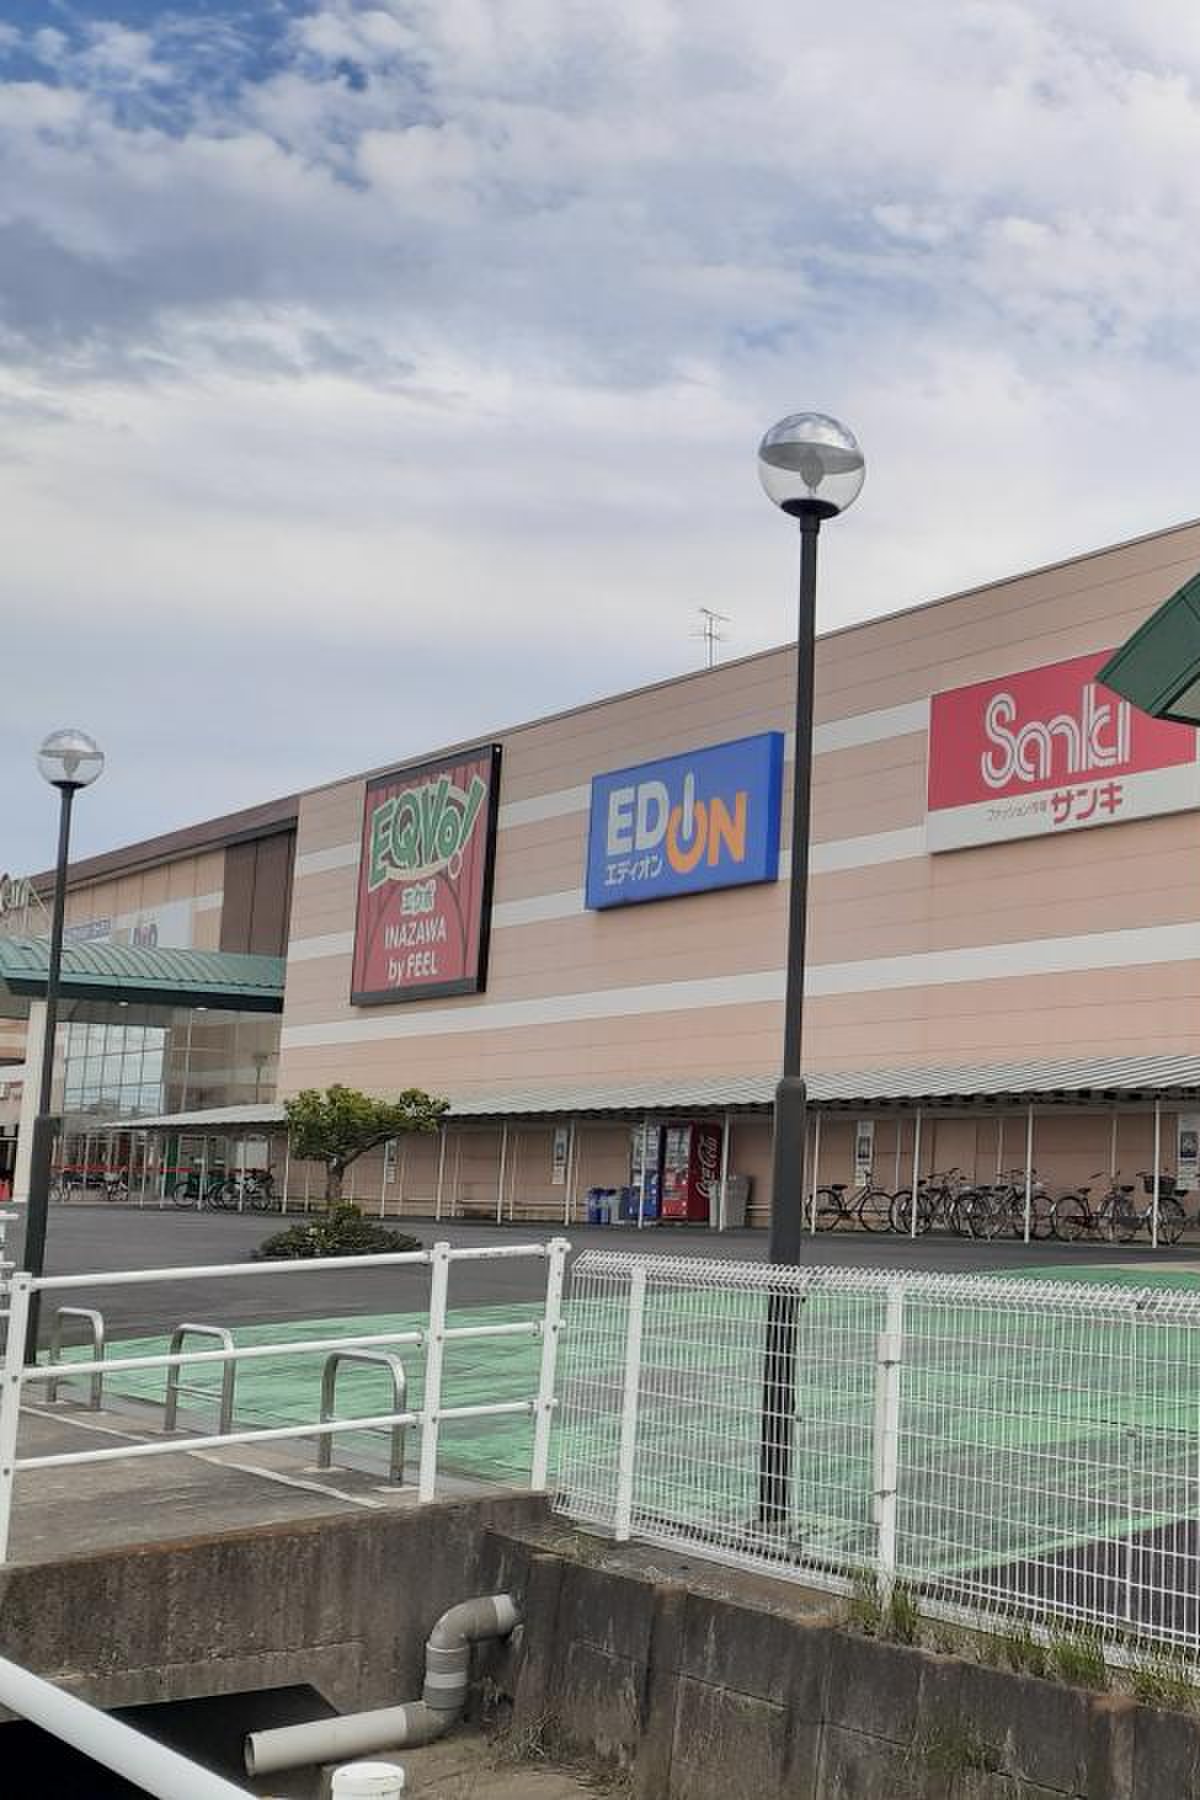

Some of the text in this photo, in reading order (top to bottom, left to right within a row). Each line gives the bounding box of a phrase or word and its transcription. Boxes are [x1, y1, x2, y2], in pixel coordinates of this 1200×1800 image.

[981, 683, 1131, 789] Sanki
[607, 772, 748, 873] EDION
[1051, 782, 1123, 826] サンキ
[605, 854, 662, 886] エディオン
[384, 916, 447, 949] INAZAWA
[388, 950, 438, 986] by FEEL
[695, 1135, 719, 1198] Coca-Cola
